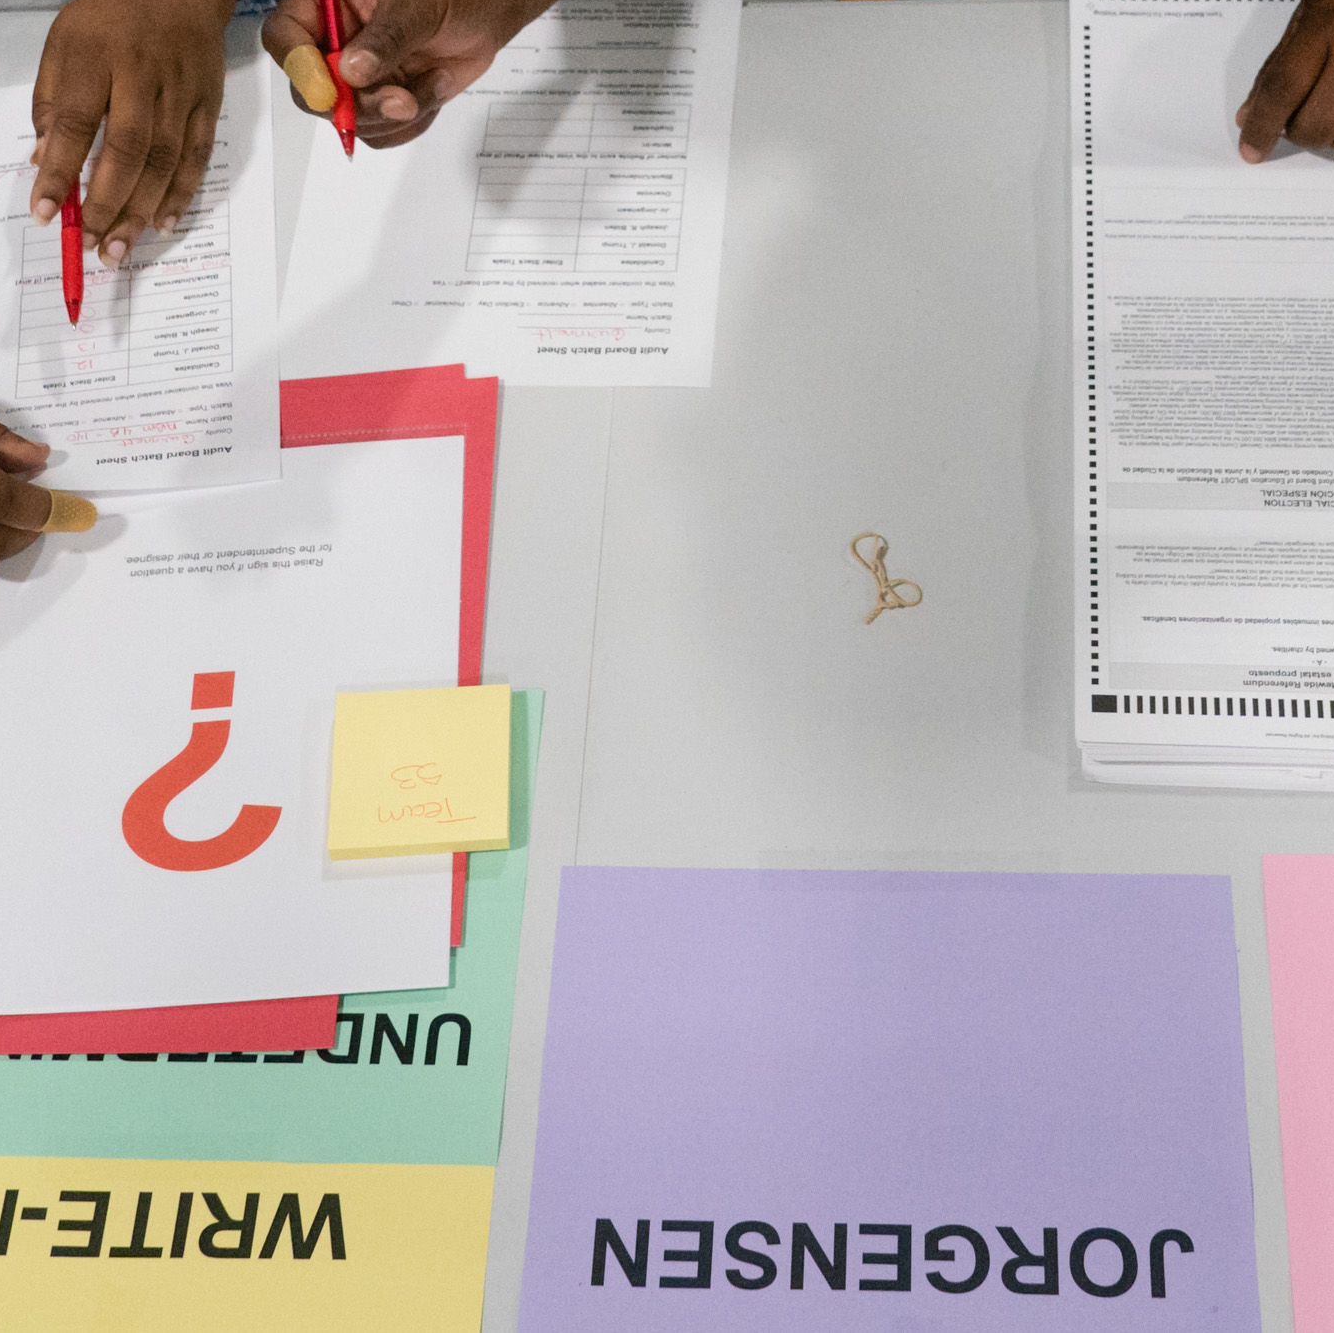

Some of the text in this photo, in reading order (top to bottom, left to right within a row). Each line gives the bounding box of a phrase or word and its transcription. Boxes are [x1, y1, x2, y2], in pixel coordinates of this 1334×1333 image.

[183, 291, 219, 300] Overvote
[190, 327, 219, 335] Joseph
[191, 344, 220, 353] Donald
[537, 347, 567, 355] Sheet
[571, 347, 602, 355] Batch
[175, 362, 220, 372] Candidates
[43, 382, 66, 390] Totals
[140, 409, 176, 418] Absentee
[210, 415, 233, 423] Batch
[205, 428, 233, 436] County
[96, 446, 232, 465] Audit Board Batch Sheet
[1176, 476, 1219, 484] Referendum
[1250, 477, 1286, 485] Education
[1260, 489, 1307, 498] ESPECIAL
[1264, 499, 1312, 507] ELECTION
[124, 544, 332, 566] for the Superintendent or their designee.
[216, 562, 235, 571] you
[247, 560, 269, 570] sign
[272, 560, 291, 568] this
[293, 558, 323, 567] Raise
[130, 566, 174, 577] question
[187, 565, 213, 574] have
[237, 564, 244, 572] if
[1305, 646, 1315, 654] by
[1249, 669, 1297, 677] propuesto
[1300, 671, 1332, 679] estatal
[1242, 680, 1301, 689] Referendum
[390, 762, 442, 789] 53
[378, 797, 476, 823] Team
[591, 1218, 1194, 1299] JORGENSEN
